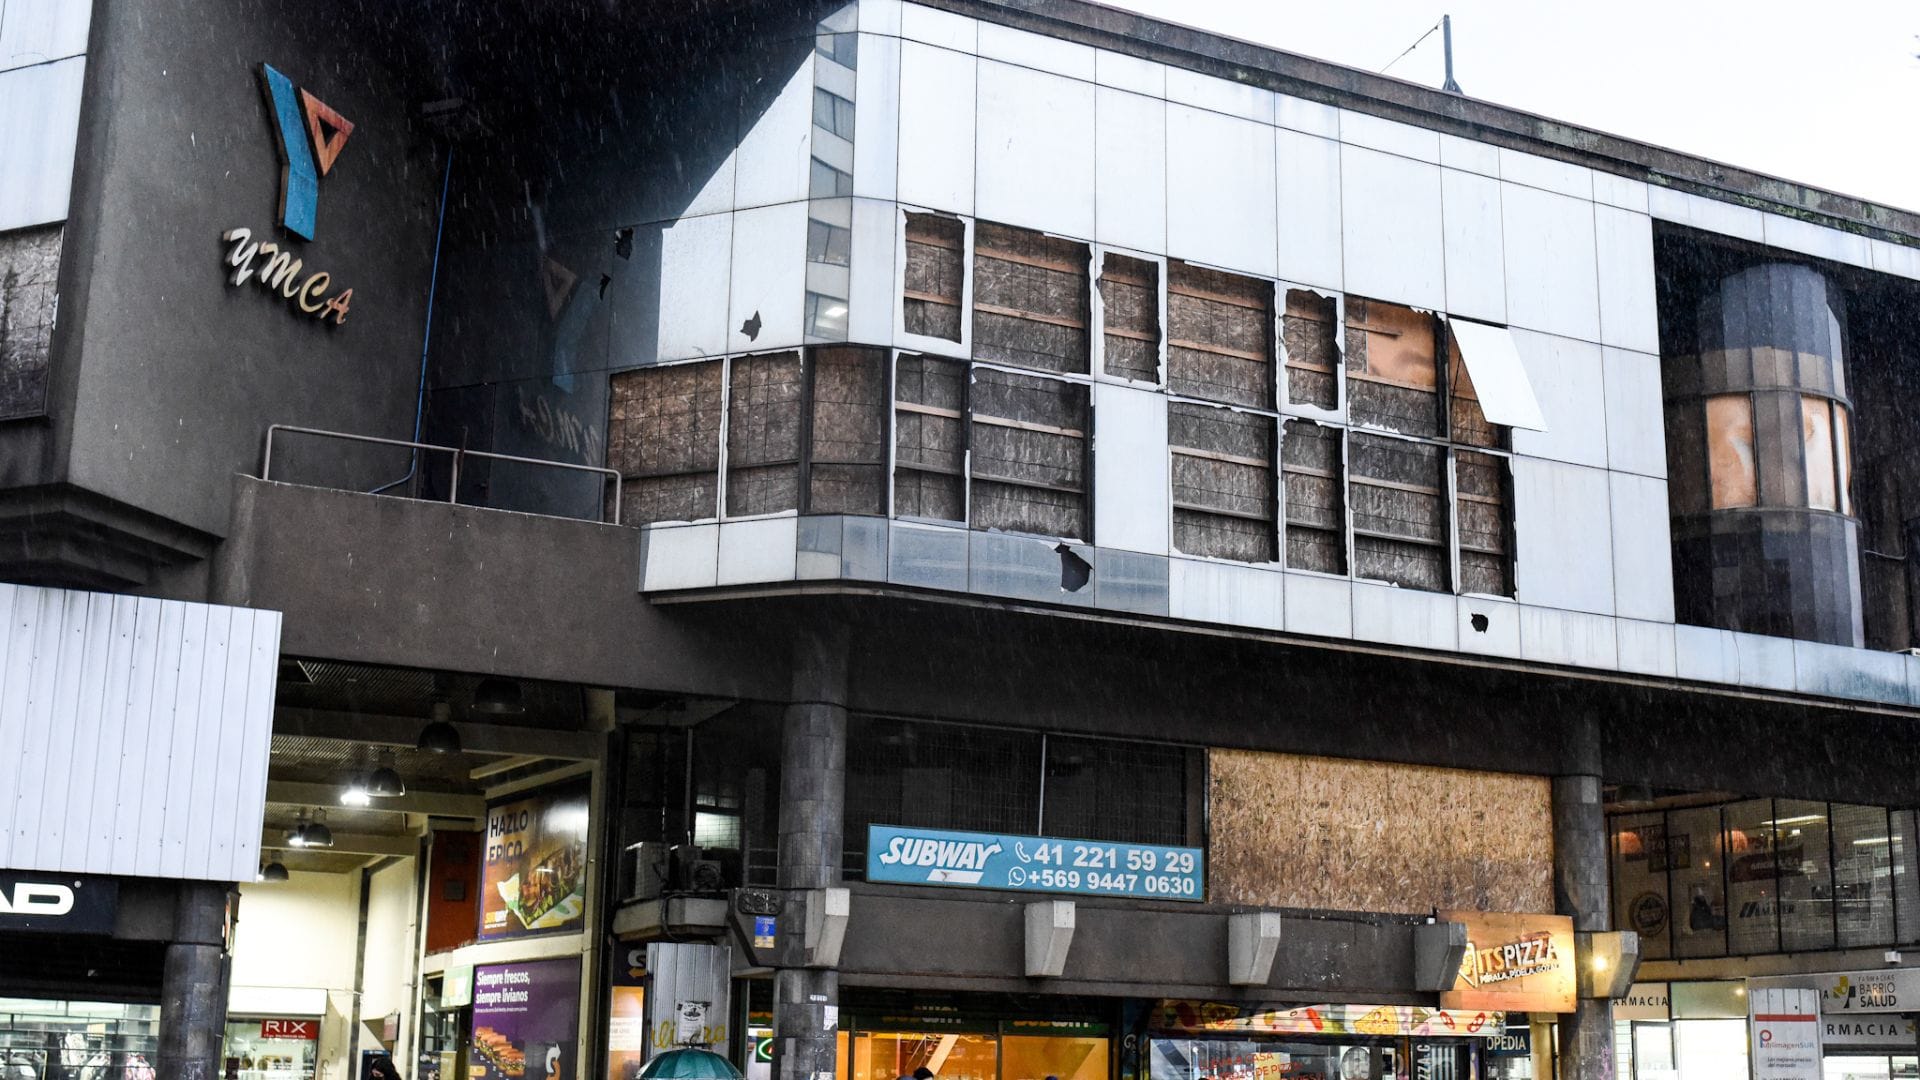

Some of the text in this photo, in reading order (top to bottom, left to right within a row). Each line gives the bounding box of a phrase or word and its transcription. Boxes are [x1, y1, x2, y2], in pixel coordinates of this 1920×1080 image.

[223, 227, 353, 325] YMCA
[491, 809, 529, 838] HAZLO
[879, 836, 1003, 870] SUBWAY
[1034, 843, 1194, 874] 41 221 59 29
[1028, 869, 1195, 895] +569 9447 0630
[477, 970, 503, 988] Siempre
[504, 968, 530, 985] frescos,
[476, 987, 528, 1006] siempre livianos
[1859, 982, 1896, 994] BARRIO
[1860, 996, 1897, 1007] SALUD
[266, 1020, 307, 1033] RIX
[1245, 1051, 1275, 1065] CASA
[1255, 1064, 1270, 1077] DE
